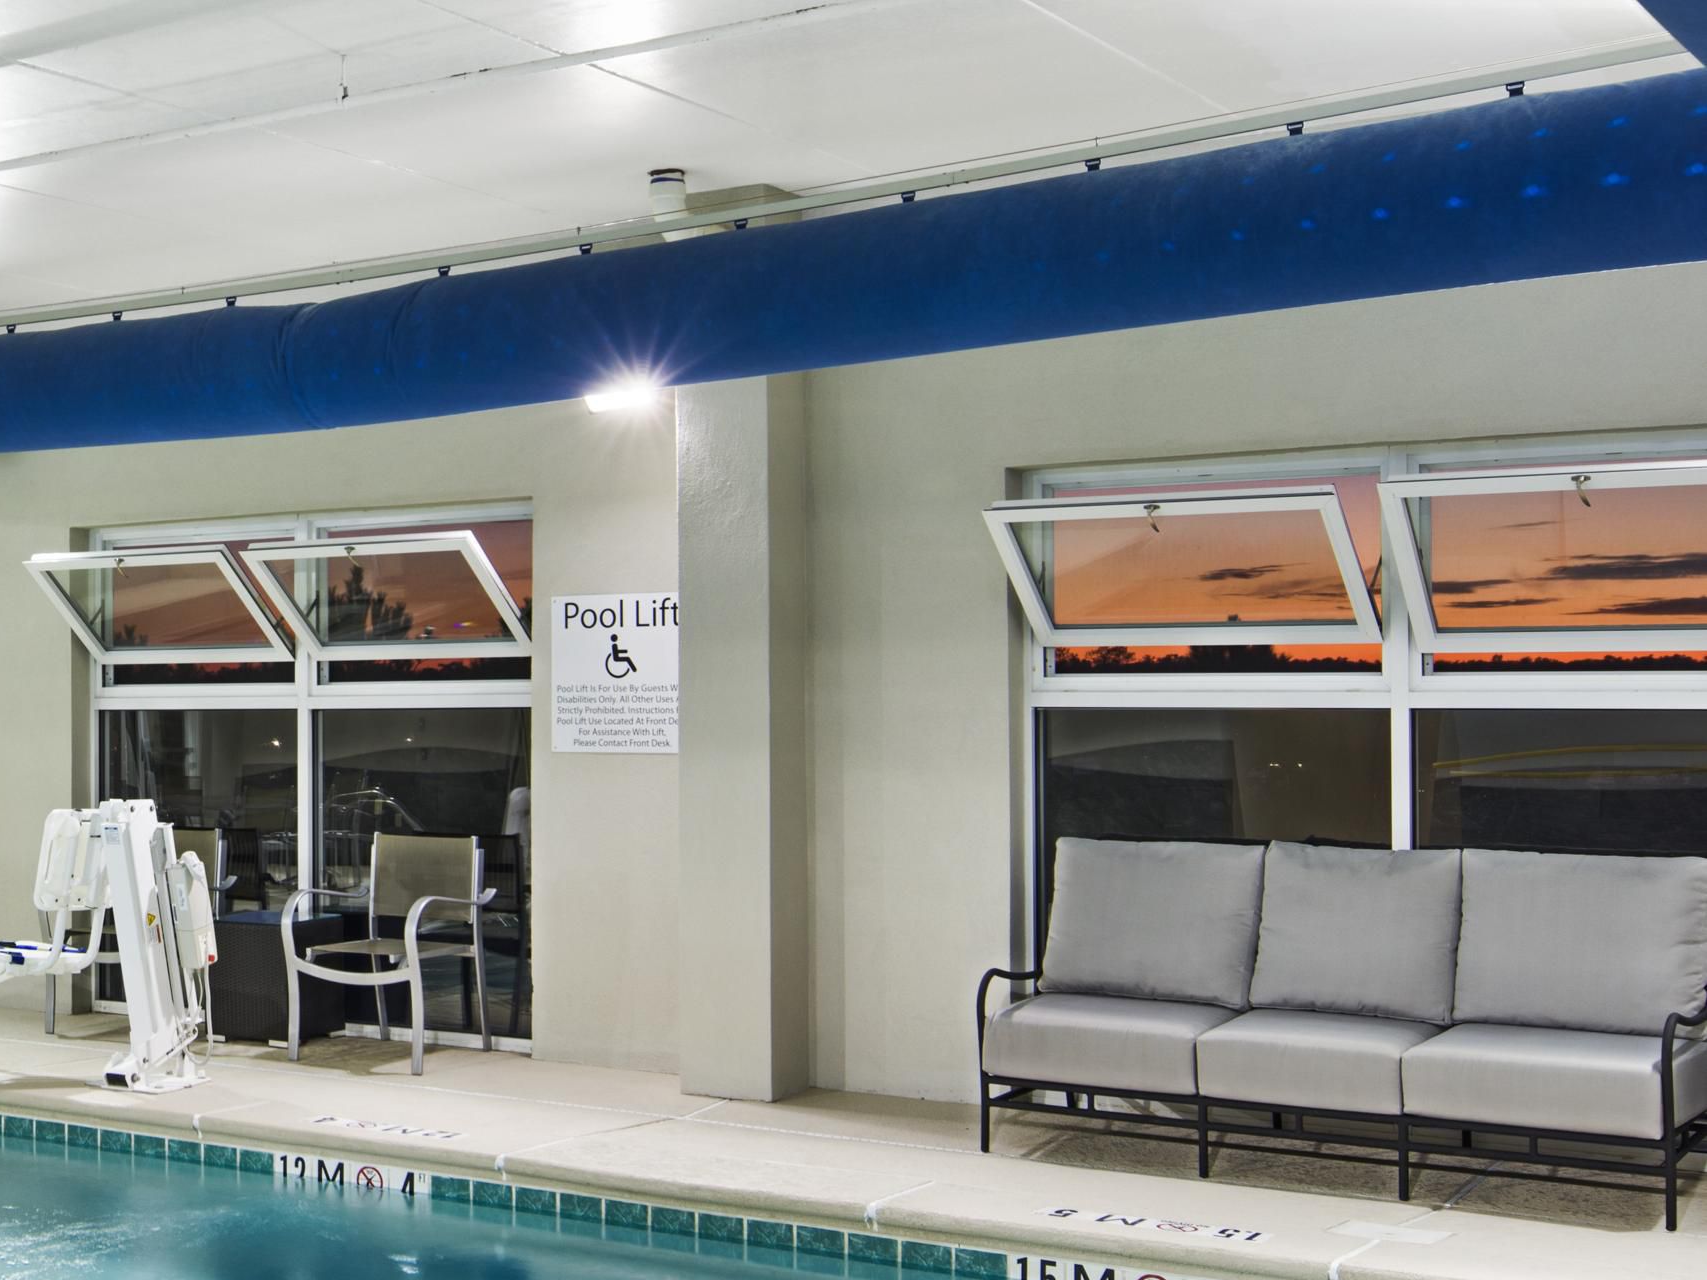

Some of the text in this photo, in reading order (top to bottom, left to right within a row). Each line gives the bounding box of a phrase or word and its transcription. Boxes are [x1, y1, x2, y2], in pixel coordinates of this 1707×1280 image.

[564, 597, 678, 629] Pool Lift
[556, 684, 574, 693] Pool
[575, 684, 588, 693] Lift
[590, 684, 596, 693] Is
[598, 684, 611, 693] For
[613, 684, 627, 693] Use
[629, 684, 638, 694] By
[641, 683, 668, 692] Guests
[556, 695, 597, 704] Disabilities
[619, 695, 630, 703] All
[631, 695, 654, 704] Other
[655, 695, 674, 704] Uses
[557, 706, 583, 716] Strictly
[584, 706, 625, 714] Prohibited.
[628, 706, 674, 714] Instructions
[556, 717, 573, 726] Pool
[574, 717, 587, 726] Lift
[589, 717, 602, 726] Use
[604, 717, 634, 726] Located
[636, 717, 644, 725] At
[646, 717, 666, 725] Front
[578, 728, 591, 737] For
[592, 728, 631, 736] Assistance
[632, 728, 650, 736] With
[573, 738, 597, 747] Please
[598, 738, 628, 747] Contact
[629, 738, 649, 747] Front
[317, 1159, 344, 1186] M
[400, 1171, 415, 1196] 4
[1048, 1208, 1078, 1218] 5
[1095, 1214, 1146, 1226] M
